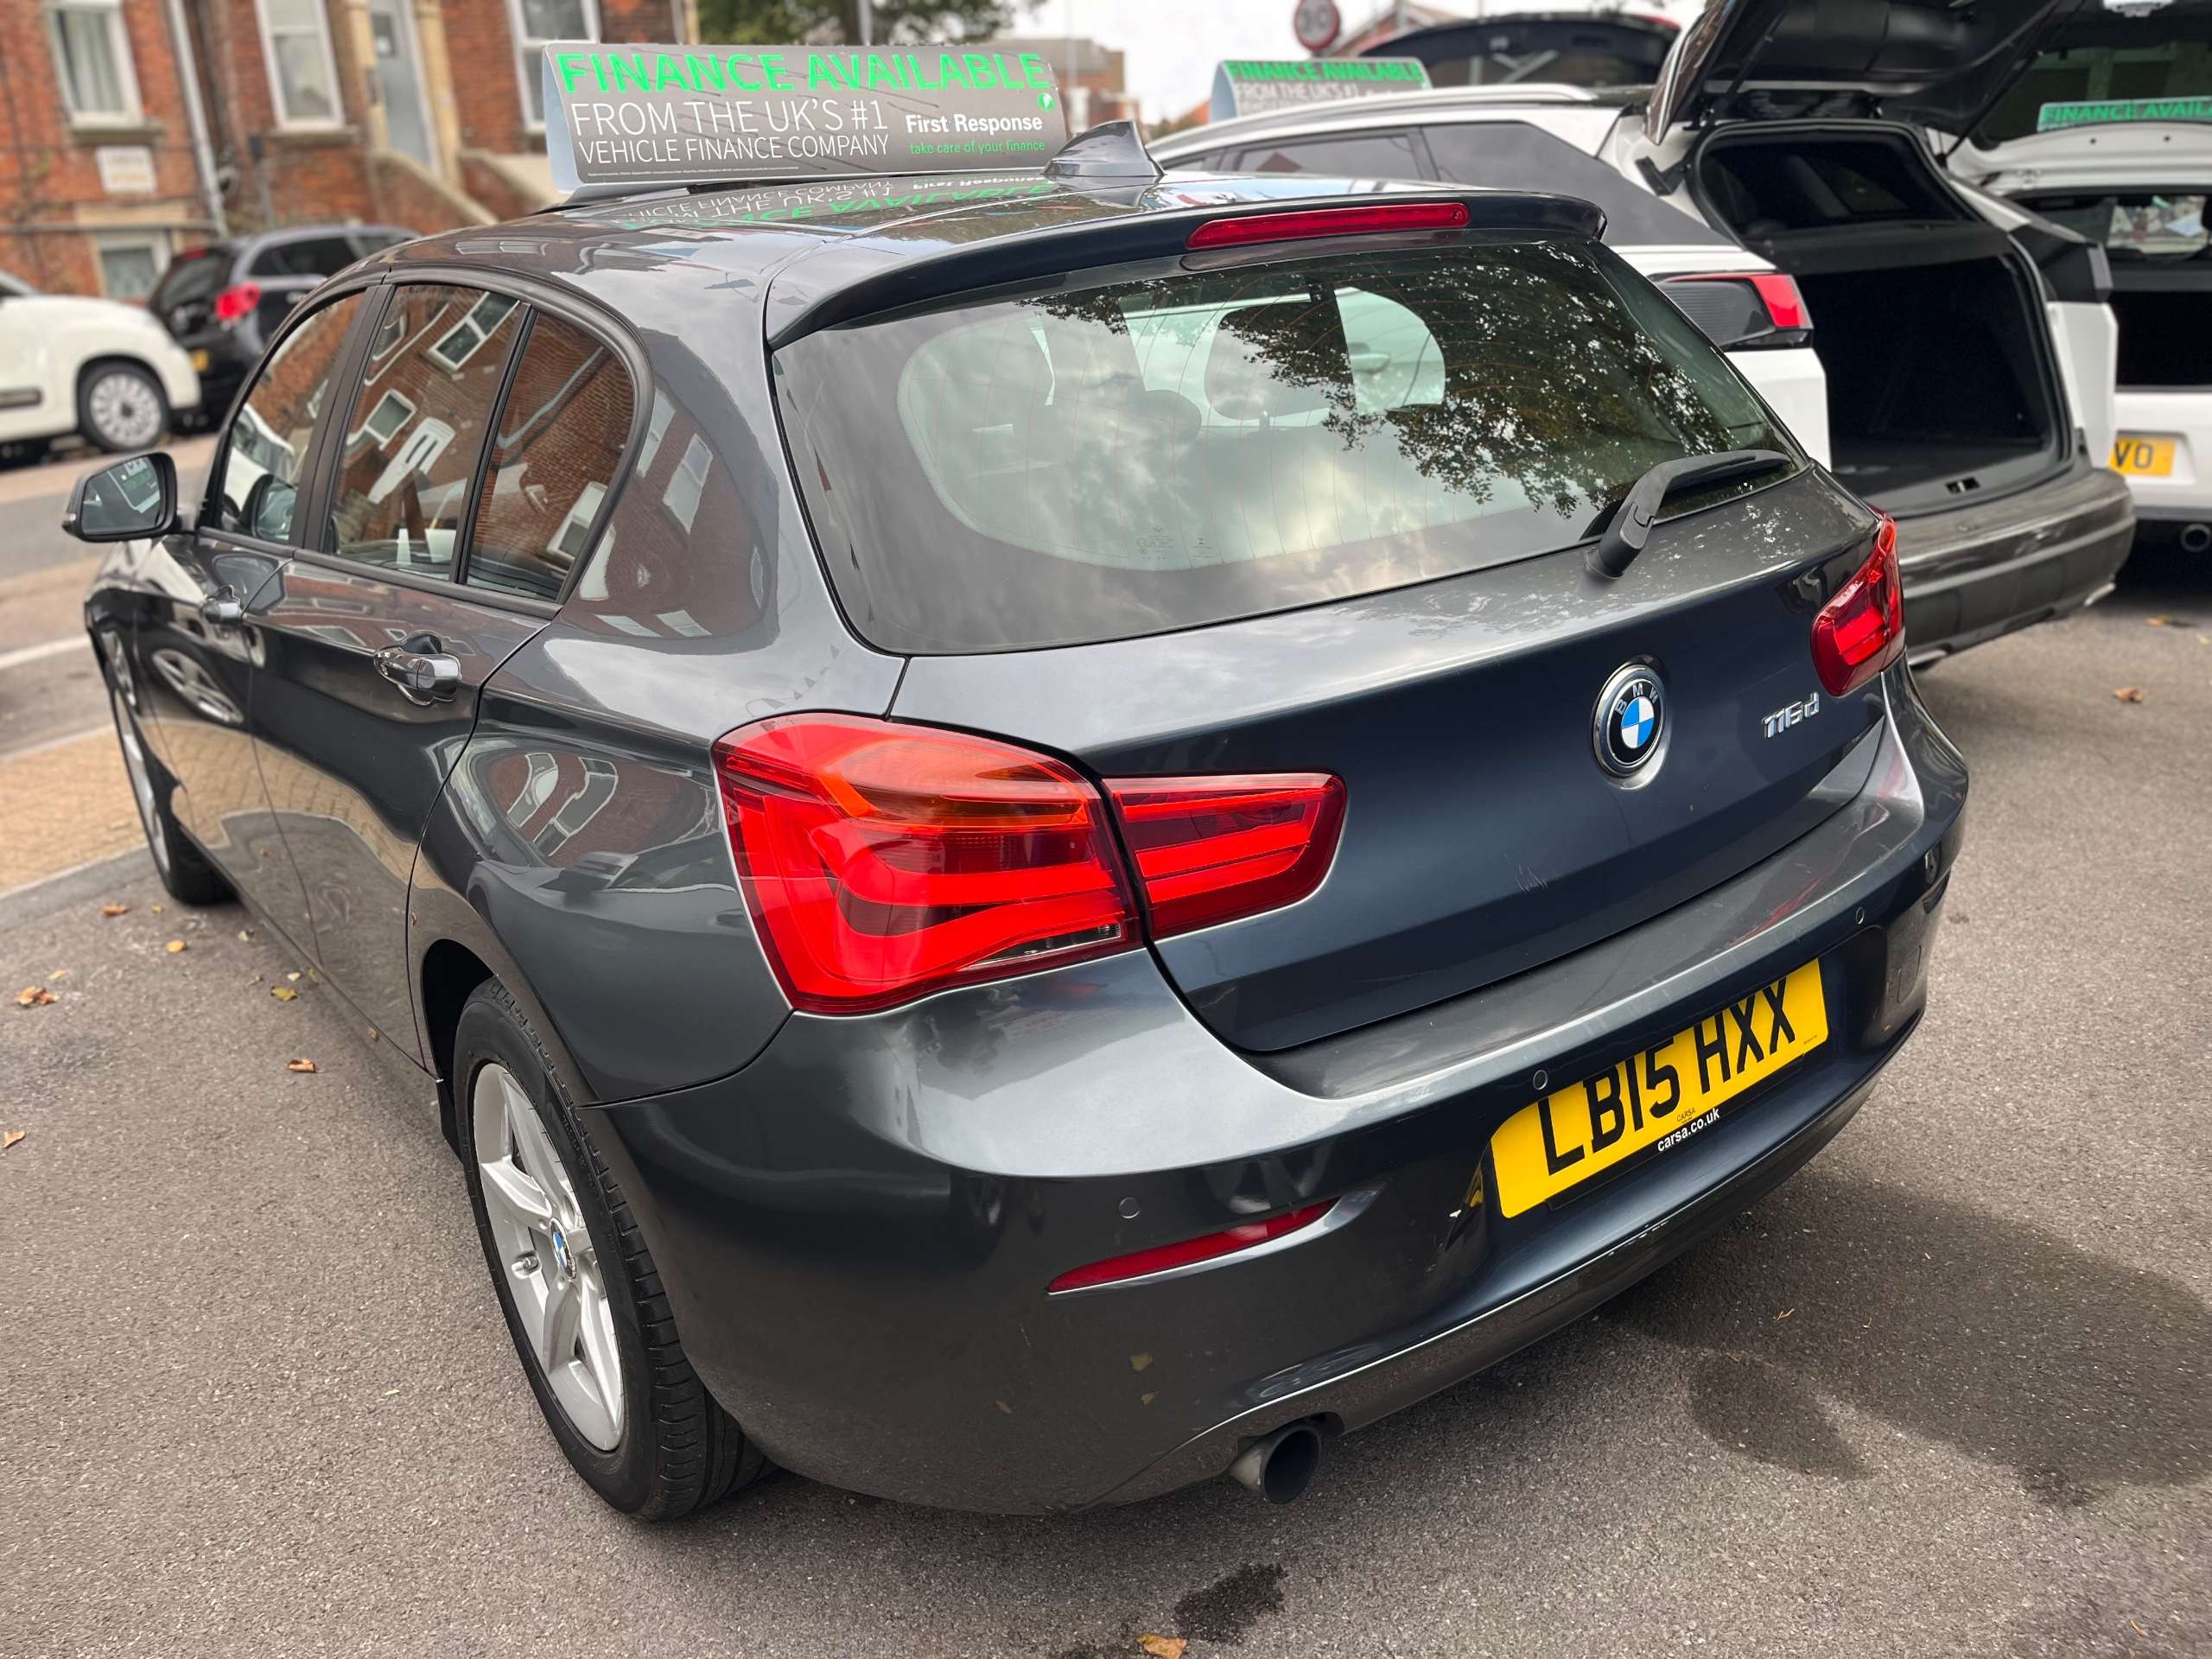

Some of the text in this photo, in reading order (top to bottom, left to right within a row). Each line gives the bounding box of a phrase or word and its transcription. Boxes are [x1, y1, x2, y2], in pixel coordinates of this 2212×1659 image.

[556, 53, 1052, 93] FINANCE AVAILABLE
[1225, 60, 1425, 82] FINANCE AVAILABLE
[571, 99, 888, 137] FROM THE UK'S #1
[905, 113, 1044, 136] First Response
[2044, 105, 2137, 125] FINANCE
[579, 134, 889, 164] VEHICLE FINANCE COMPANY
[911, 140, 1046, 156] take care of your finance
[1614, 682, 1659, 715] BMW
[1762, 691, 1820, 740] 116d
[1537, 975, 1796, 1177] LB15 HXX
[1656, 1107, 1720, 1152] carsa.co.uk
[1676, 1106, 1696, 1122] CARSA
